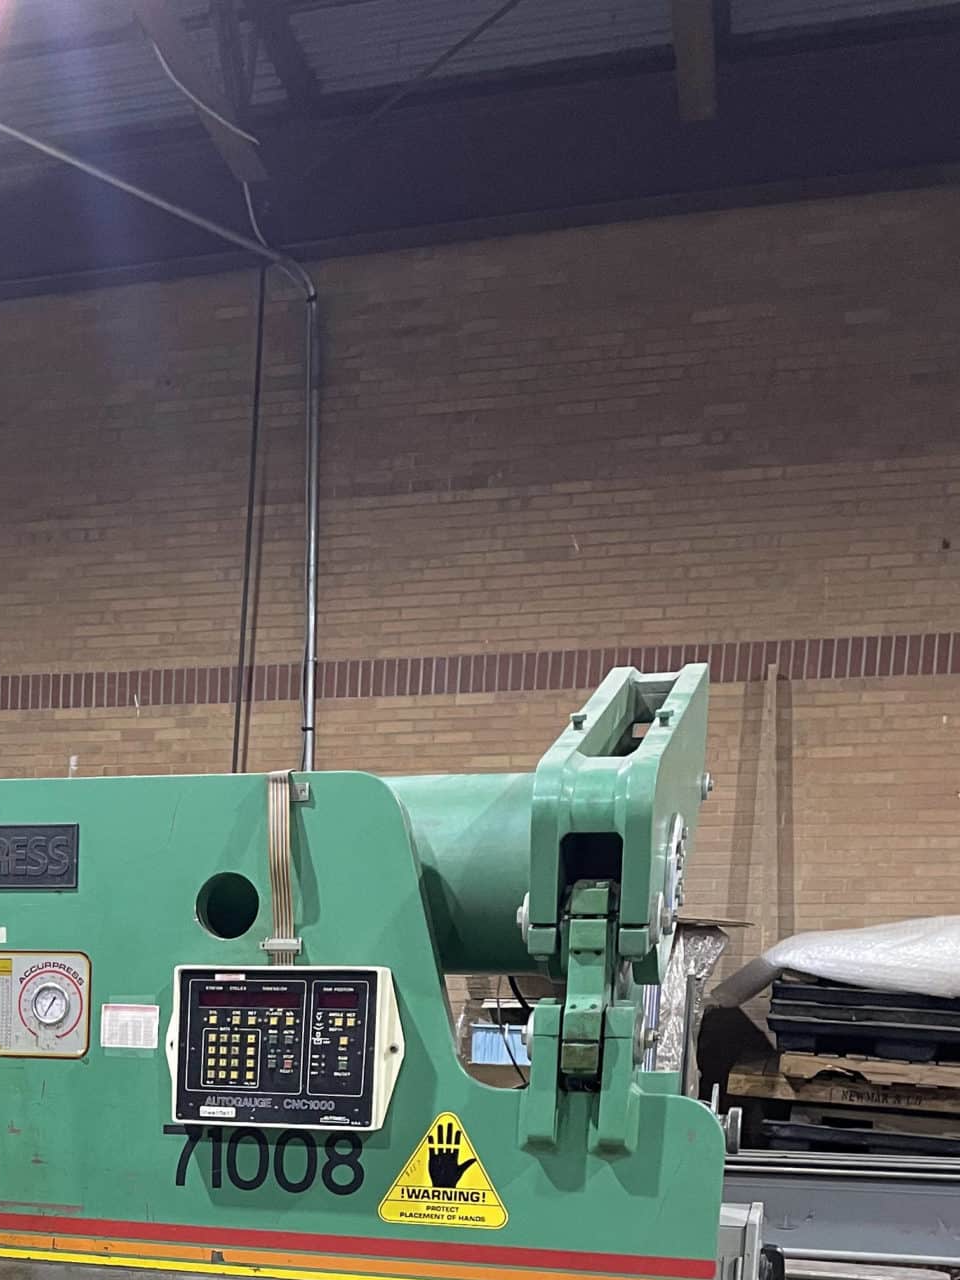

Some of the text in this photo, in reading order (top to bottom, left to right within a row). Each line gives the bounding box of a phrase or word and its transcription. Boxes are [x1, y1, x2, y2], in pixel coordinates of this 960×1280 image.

[18, 961, 85, 986] ACCURPRESS
[204, 1095, 336, 1111] AUTOGAUGE CNC1000
[163, 1124, 365, 1196] 71008
[400, 1188, 486, 1203] !WARNING!
[426, 1205, 459, 1213] PROTECT
[399, 1212, 445, 1220] PLACEMENT
[458, 1214, 486, 1222] HANDS
